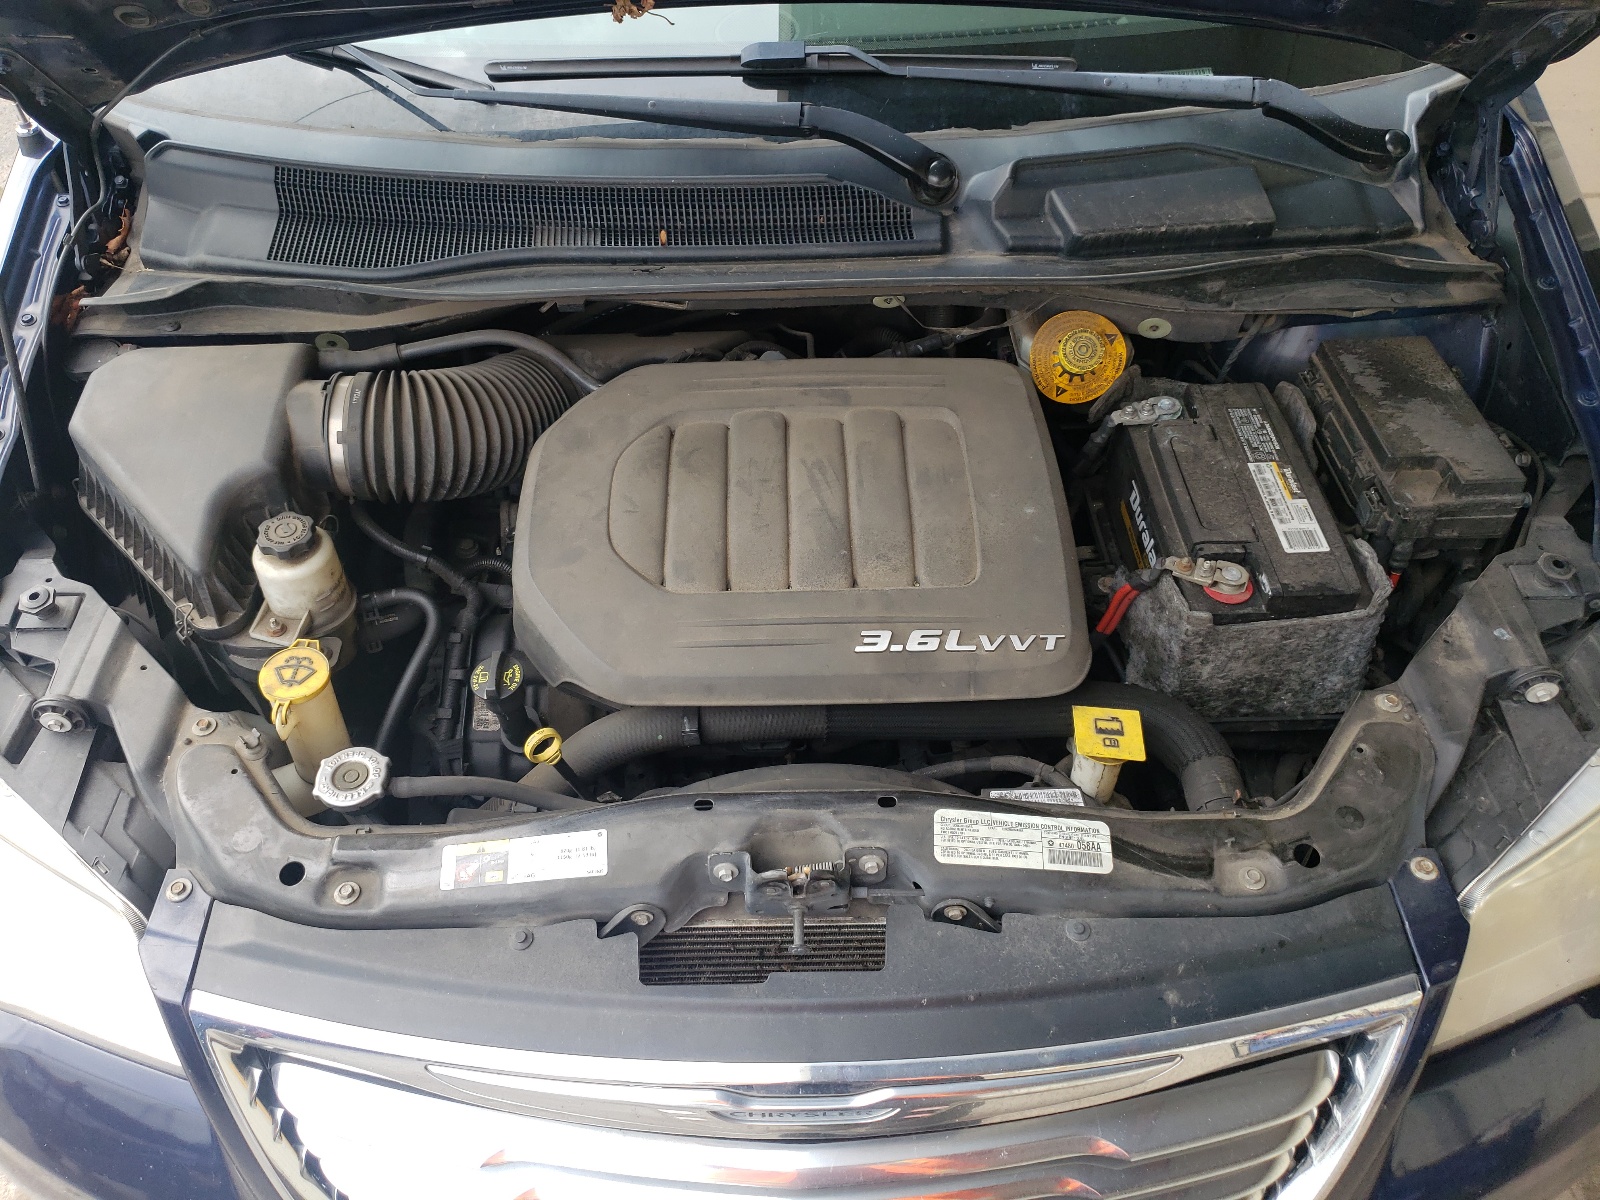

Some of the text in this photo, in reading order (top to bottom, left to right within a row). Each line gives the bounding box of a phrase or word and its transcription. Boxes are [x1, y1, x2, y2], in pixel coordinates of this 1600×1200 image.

[1283, 467, 1301, 494] Duralast
[1129, 480, 1157, 569] Durala
[854, 629, 1066, 653] 3.6L VVT
[980, 818, 991, 826] LLC
[1041, 823, 1063, 831] CONTROL
[1065, 826, 1100, 834] INFORMATION
[1077, 840, 1102, 851] 058AA
